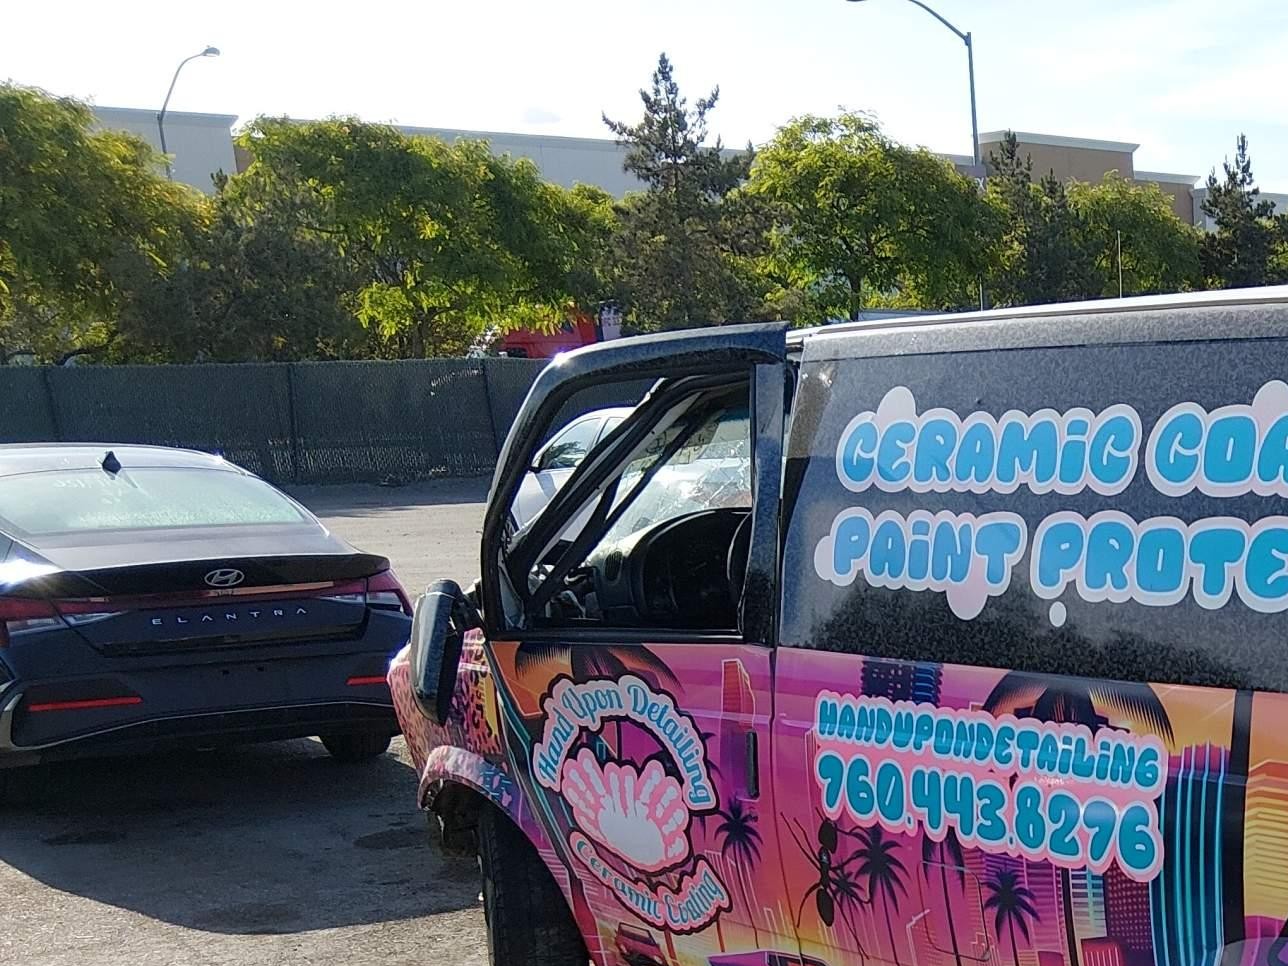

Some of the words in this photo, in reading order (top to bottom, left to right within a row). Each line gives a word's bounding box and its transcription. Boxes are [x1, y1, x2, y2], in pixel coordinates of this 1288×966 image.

[839, 403, 1136, 488] CERAMIC
[831, 514, 1022, 585] PAINT
[151, 607, 308, 626] ELANTRA
[537, 707, 576, 785] Hand
[561, 686, 624, 724] Upon
[626, 683, 713, 806] Detailing
[818, 699, 1161, 788] HANDUPONDETAILING
[817, 753, 1157, 871] 760.443.8276
[575, 839, 662, 920] Ceramic
[663, 868, 726, 926] Coating
